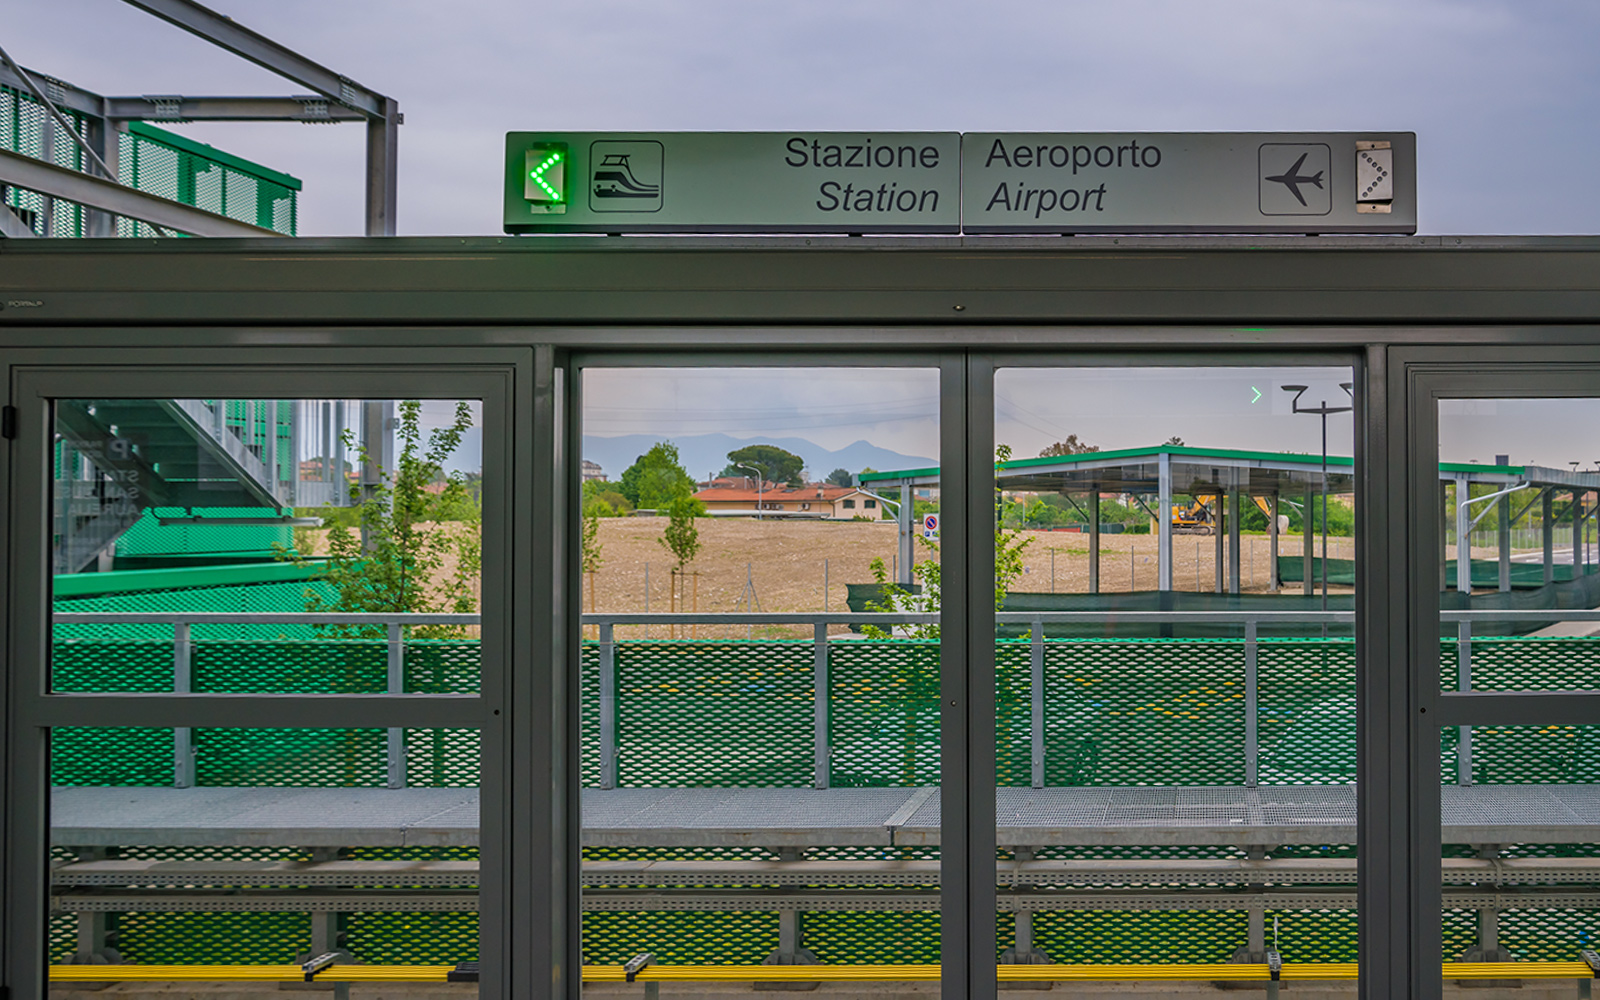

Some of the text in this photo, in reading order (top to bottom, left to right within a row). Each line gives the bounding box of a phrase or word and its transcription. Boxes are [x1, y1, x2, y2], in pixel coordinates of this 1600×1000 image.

[785, 137, 940, 168] Stazione
[985, 138, 1162, 175] Aeroporto
[816, 181, 940, 212] Station
[985, 182, 1107, 219] Airport
